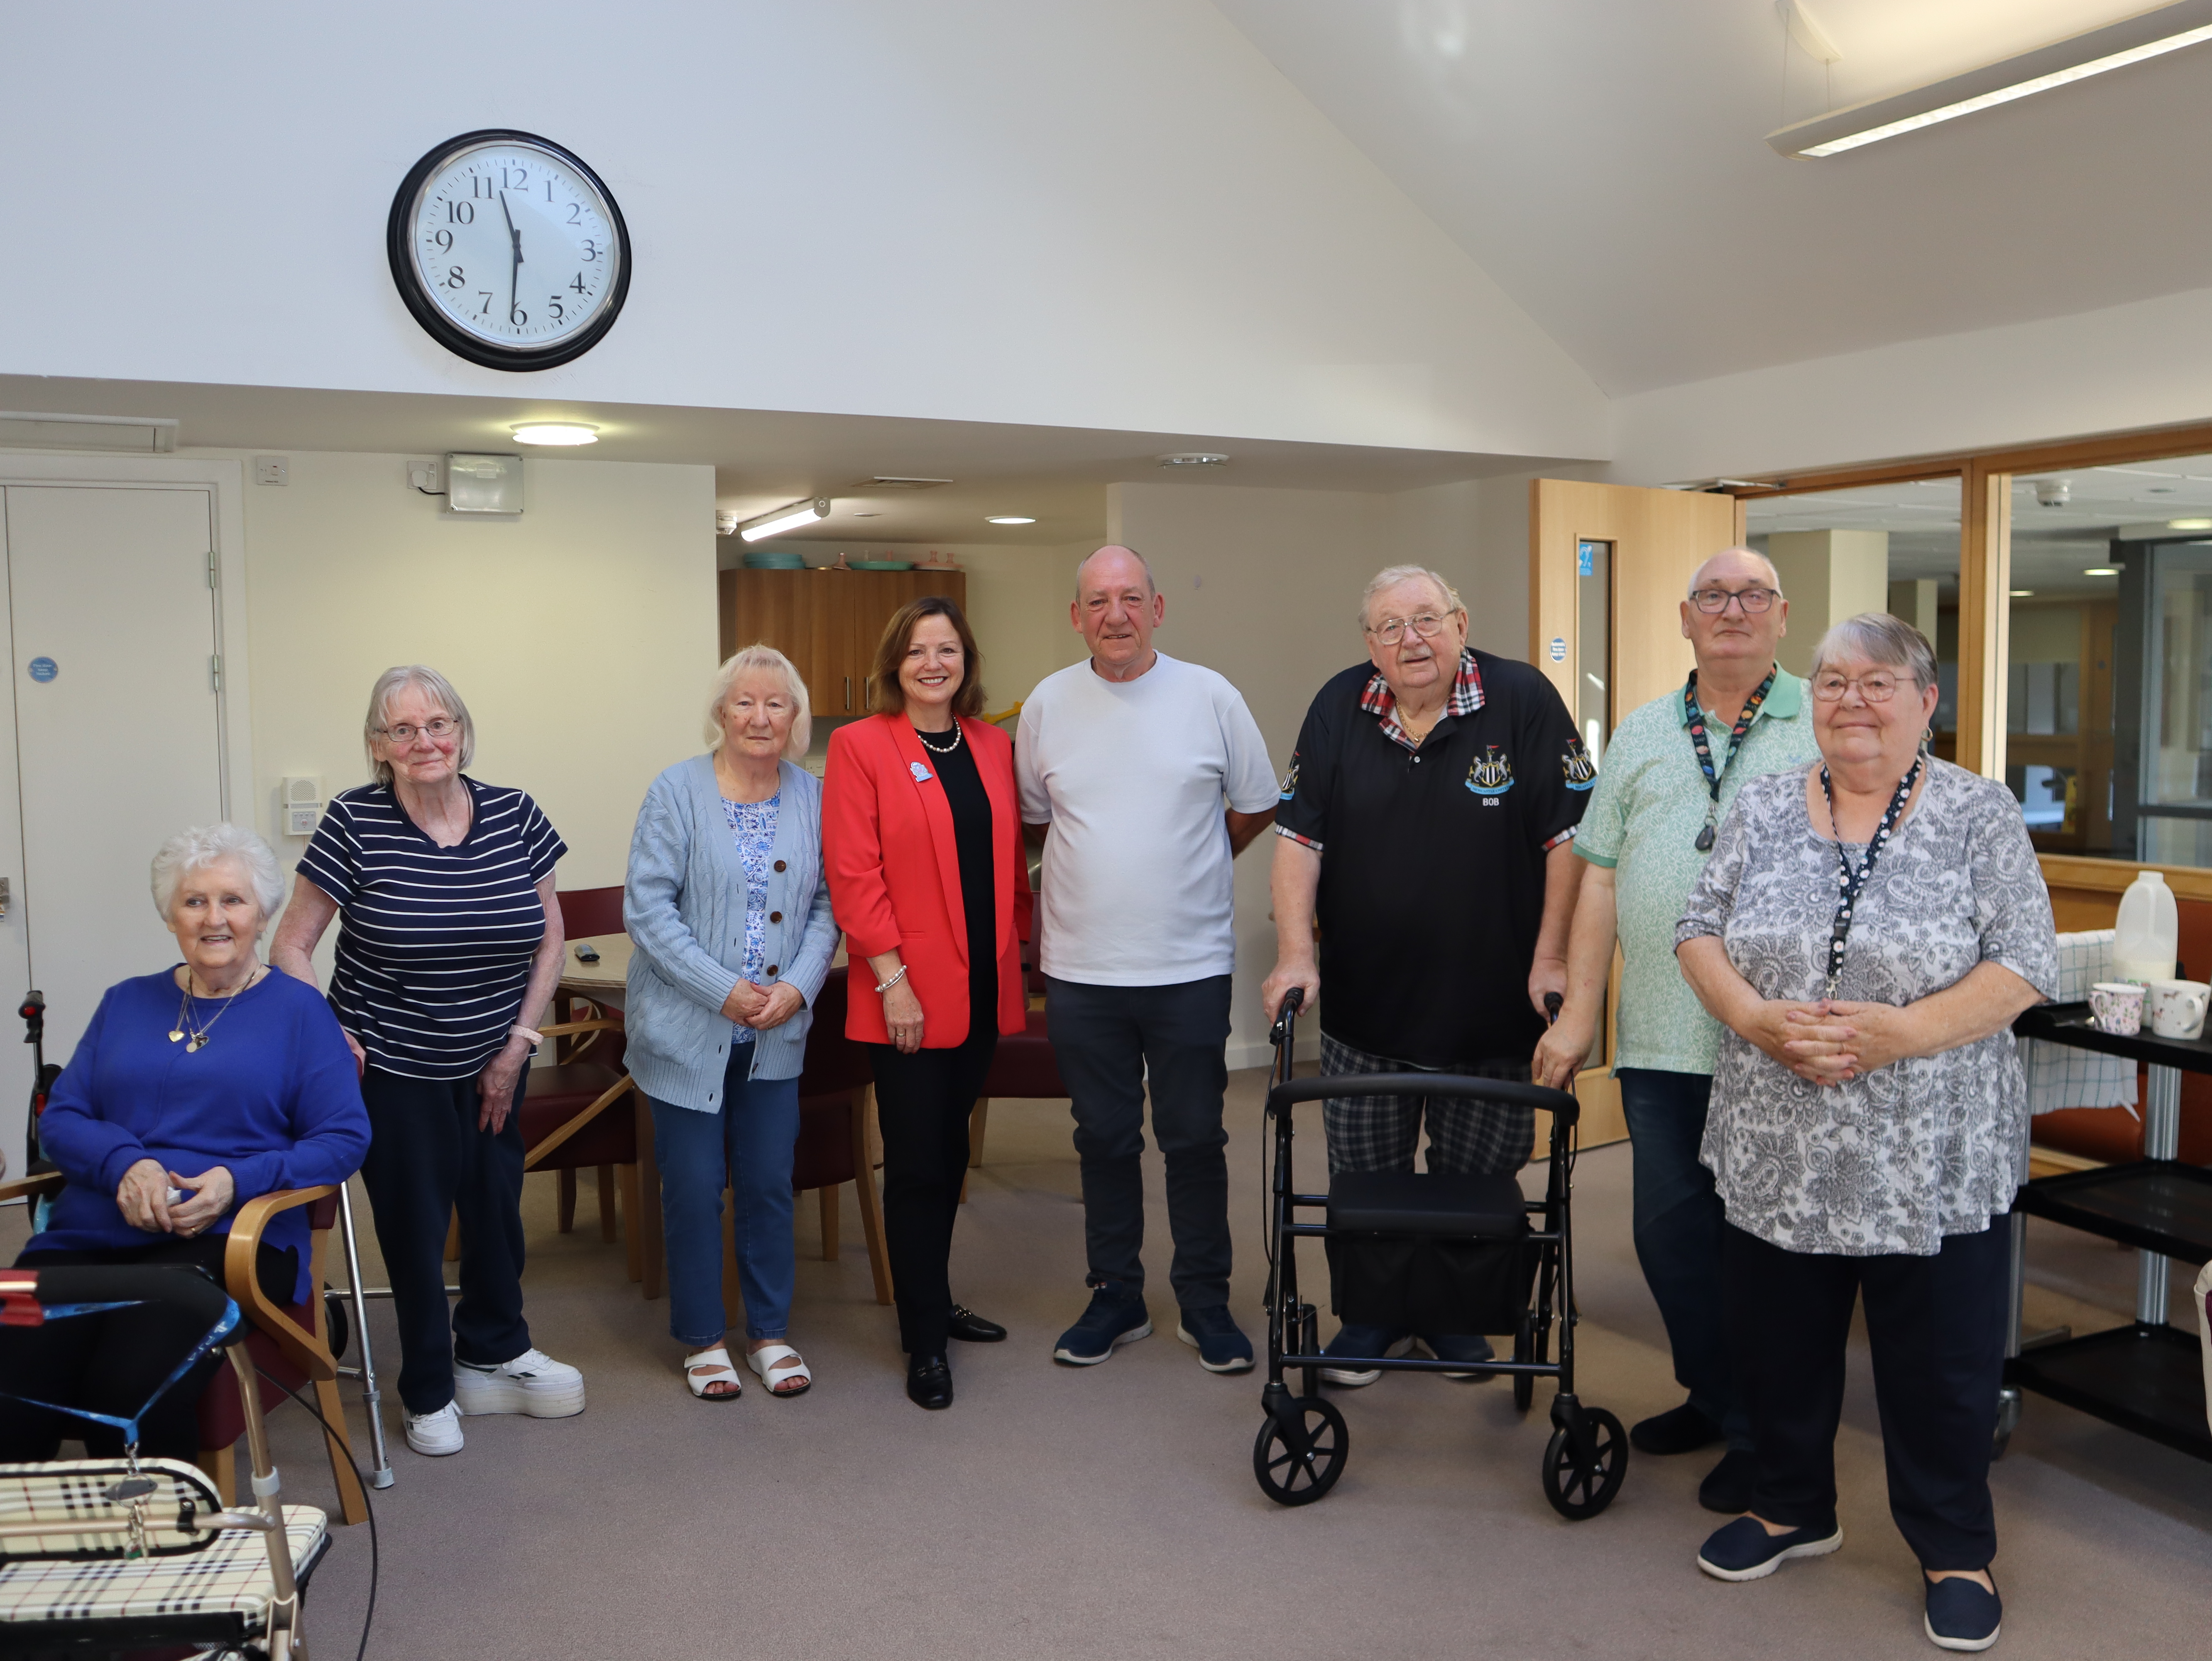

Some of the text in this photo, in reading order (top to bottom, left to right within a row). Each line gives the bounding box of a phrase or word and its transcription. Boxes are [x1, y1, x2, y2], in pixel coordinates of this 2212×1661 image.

[470, 175, 494, 199] 11
[501, 167, 529, 192] 12
[544, 179, 555, 203] 1
[445, 200, 475, 225] 10
[565, 202, 582, 226] 2
[435, 229, 453, 255] 9
[580, 239, 597, 262] 3
[448, 266, 465, 289] 8
[569, 271, 586, 294] 4
[478, 290, 493, 314] 7
[510, 301, 528, 326] 6
[548, 295, 563, 318] 5
[1483, 798, 1500, 806] BOB
